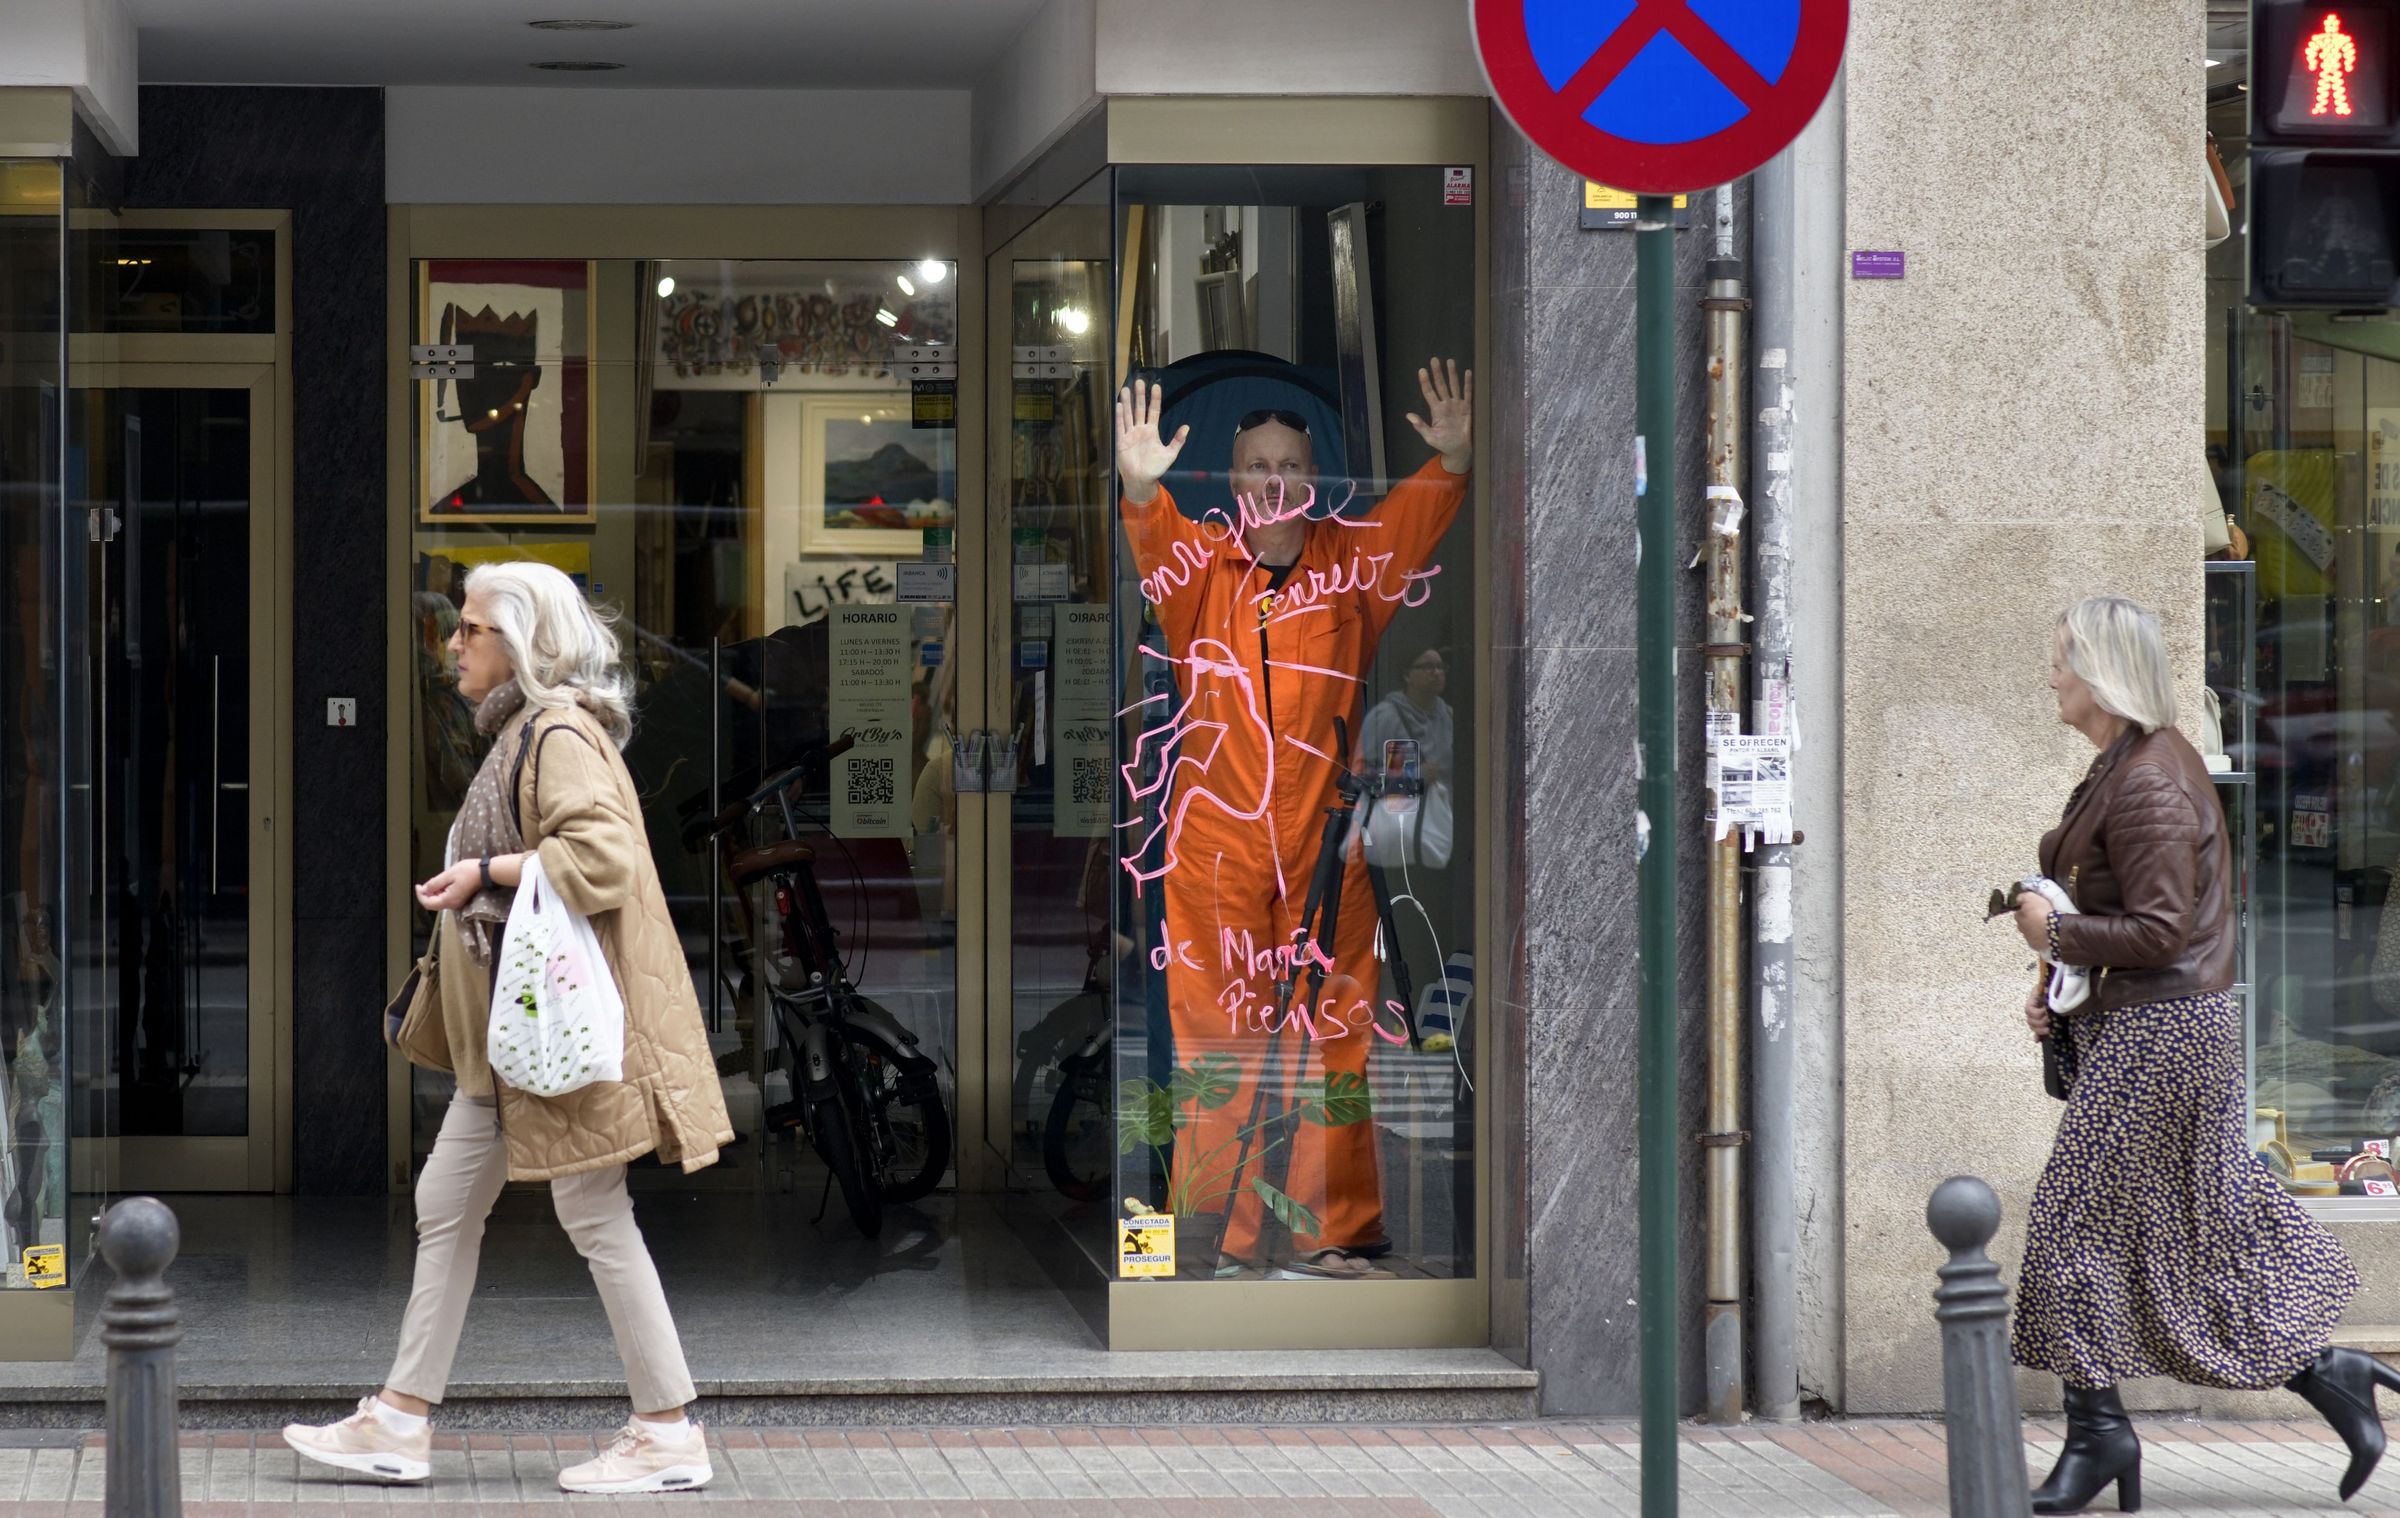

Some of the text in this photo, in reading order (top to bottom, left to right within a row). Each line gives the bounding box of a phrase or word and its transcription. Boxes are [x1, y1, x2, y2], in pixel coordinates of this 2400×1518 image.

[1614, 211, 1630, 219] 900
[842, 613, 898, 623] HORARIO
[840, 638, 863, 646] LUNES
[870, 638, 900, 646] VIERNES
[1722, 738, 1787, 747] SE OFRECEN
[1150, 918, 1205, 971] de
[2367, 1182, 2385, 1195] 6
[1123, 1255, 1171, 1263] PROSEGUR
